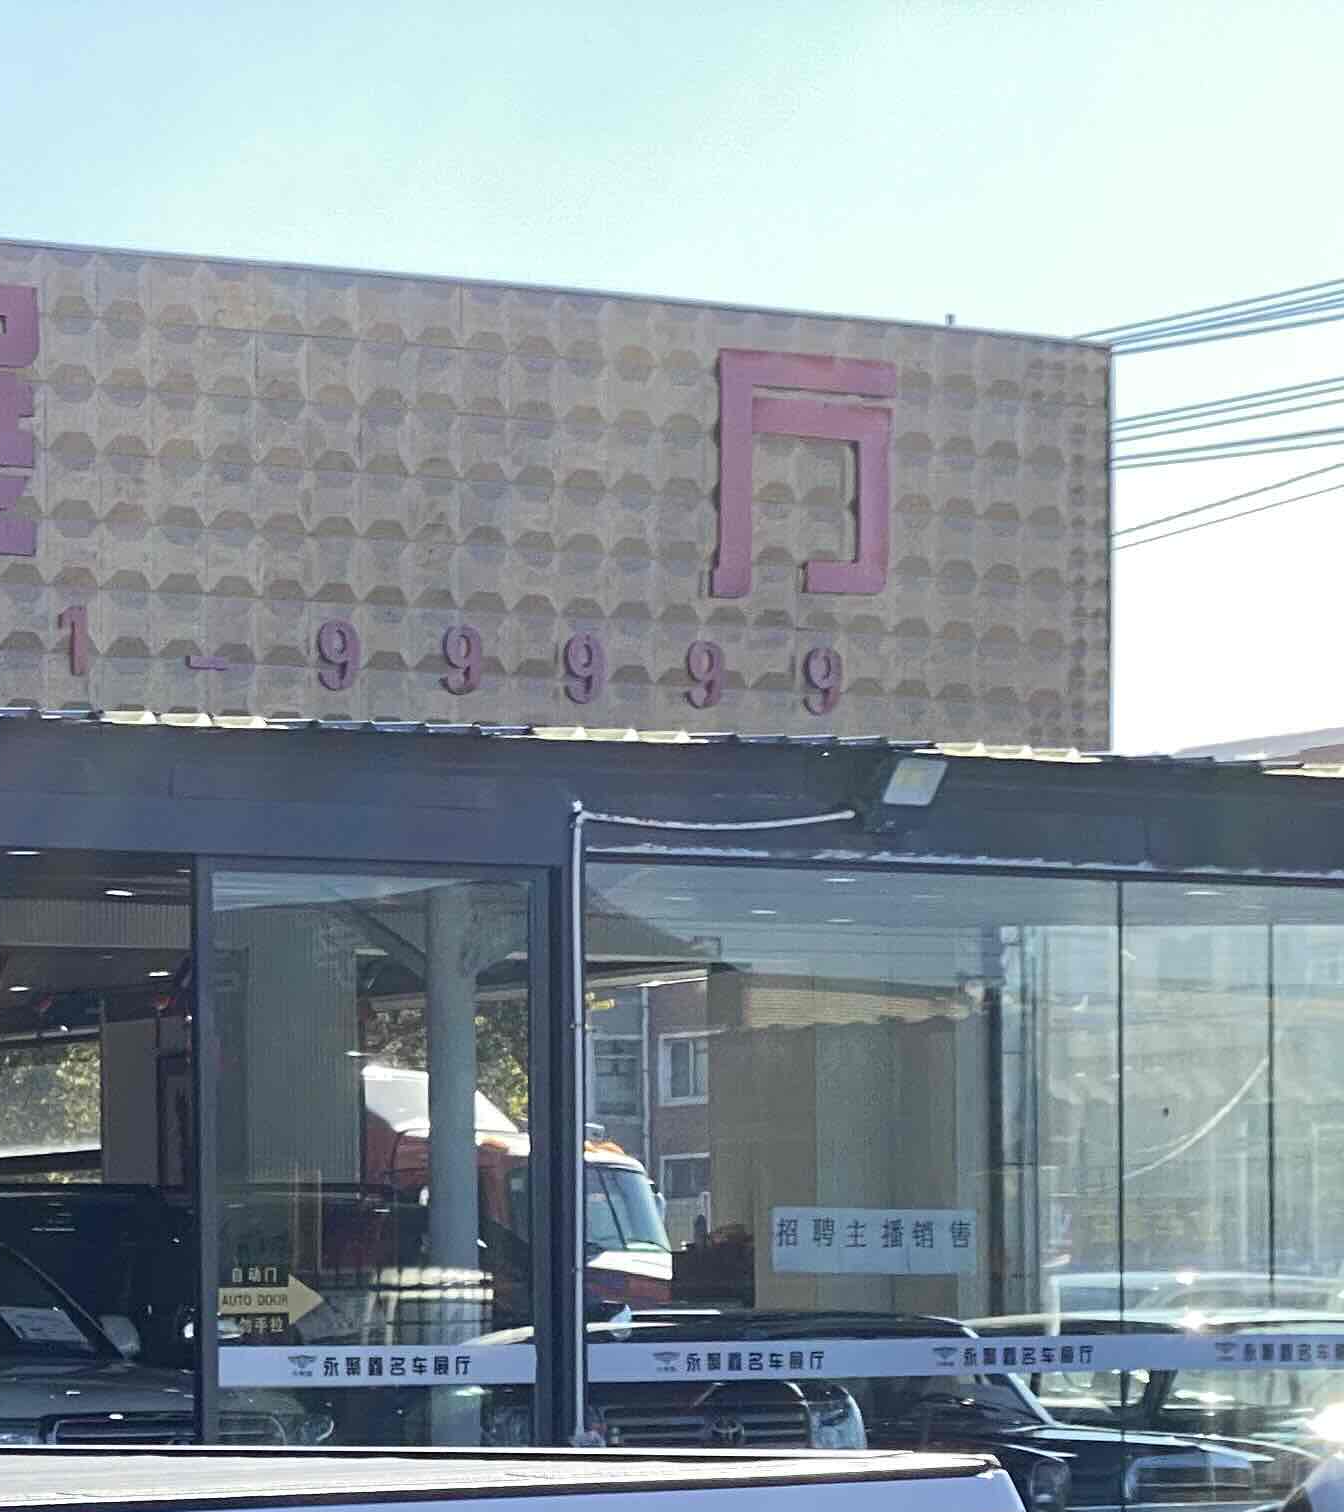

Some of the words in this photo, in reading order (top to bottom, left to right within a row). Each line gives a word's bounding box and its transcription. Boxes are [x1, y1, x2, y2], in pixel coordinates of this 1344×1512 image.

[775, 1216, 972, 1249] 招聘主播销售
[231, 1267, 279, 1283] 自动门
[221, 1294, 252, 1307] AUTO
[256, 1293, 289, 1306] DOOR
[223, 1317, 284, 1335] 勿手拉
